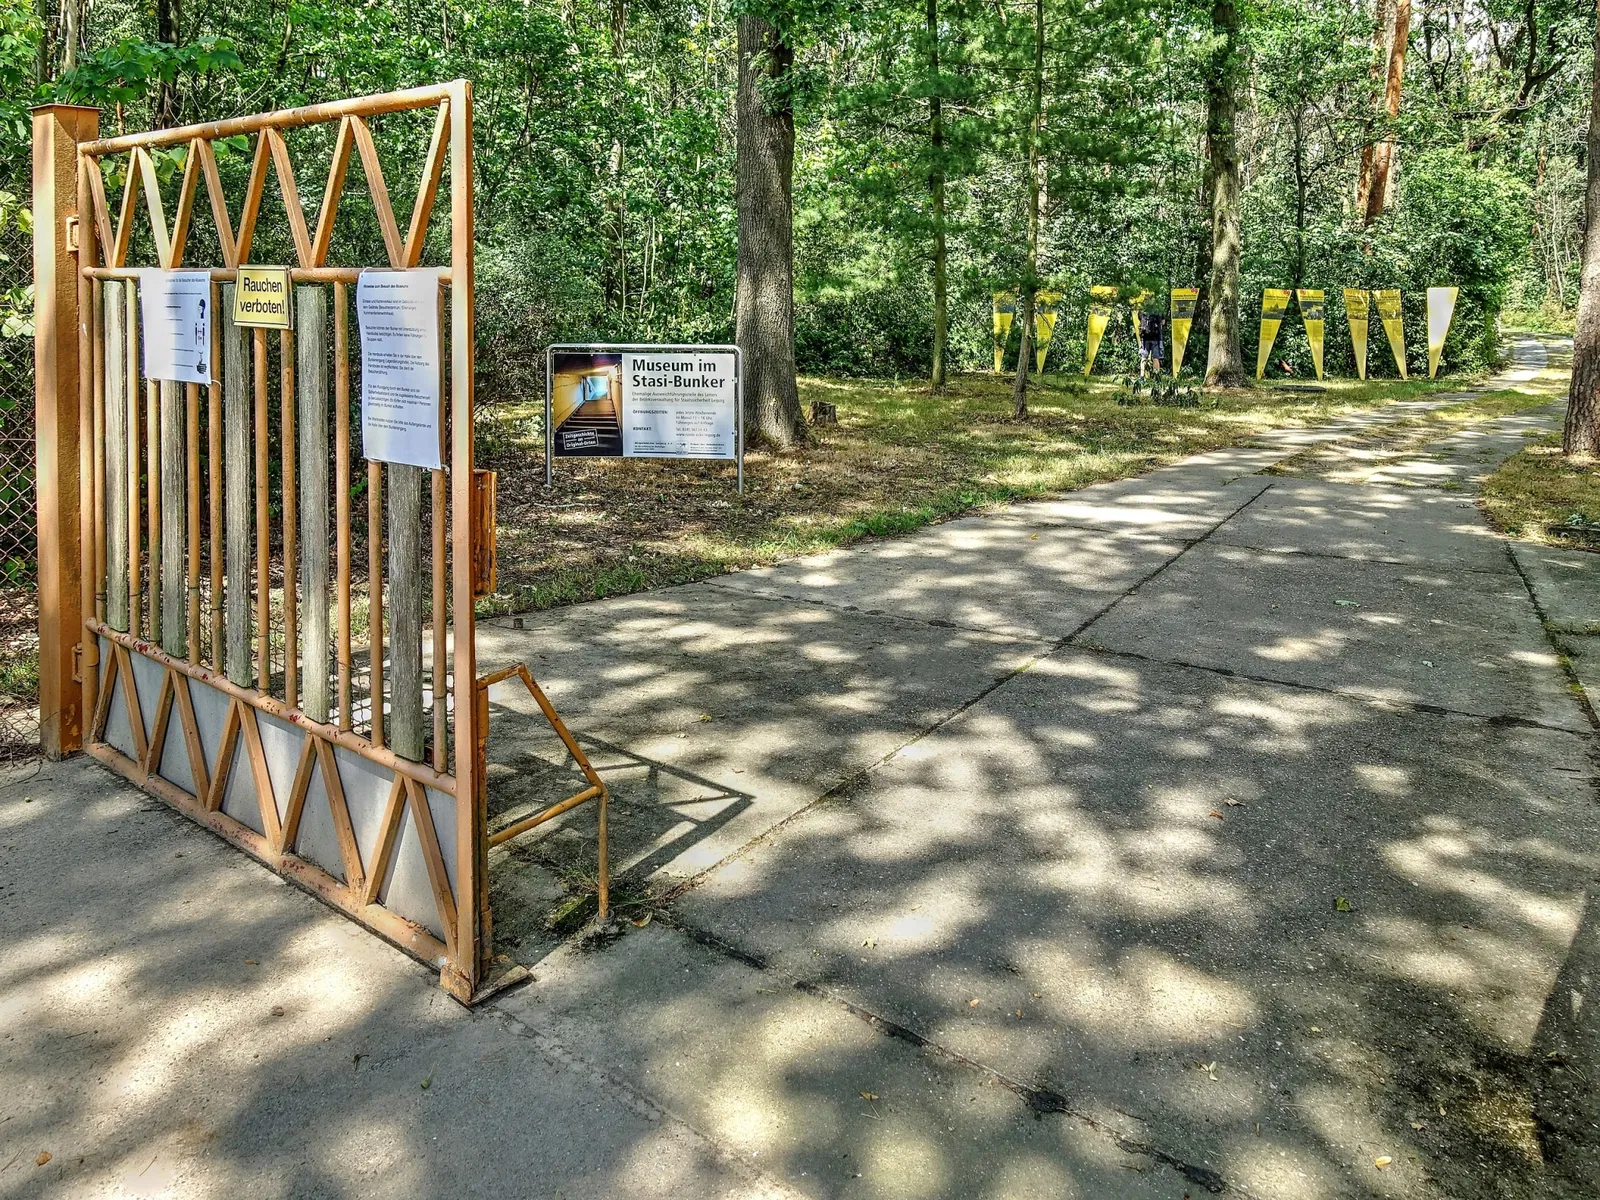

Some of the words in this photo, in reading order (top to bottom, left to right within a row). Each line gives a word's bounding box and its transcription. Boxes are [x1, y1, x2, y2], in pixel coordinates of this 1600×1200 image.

[243, 277, 283, 293] Rauchen
[240, 297, 285, 315] verboten!
[632, 359, 693, 372] Museum
[699, 359, 716, 372] im
[632, 374, 726, 388] Stasi-Bunker
[565, 431, 595, 439] Zeitgeschichte
[566, 440, 596, 448] Original-Orten
